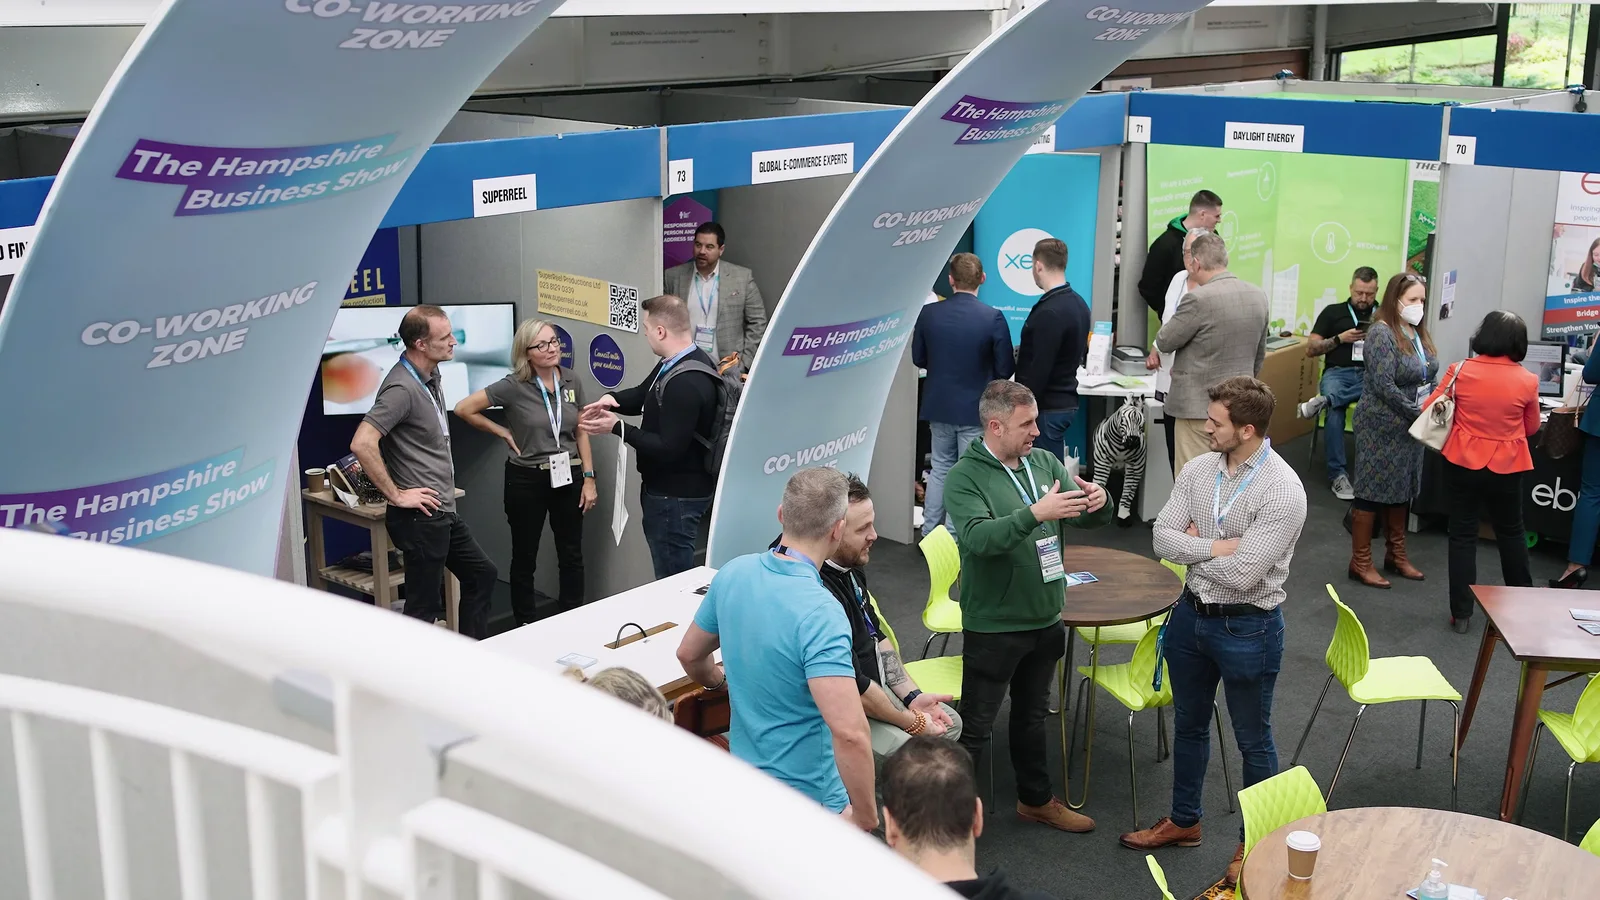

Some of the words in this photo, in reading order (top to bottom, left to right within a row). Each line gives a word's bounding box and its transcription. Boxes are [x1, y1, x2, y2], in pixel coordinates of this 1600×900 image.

[284, 0, 541, 24] CO-WORKING
[338, 28, 457, 49] ZONE
[1094, 27, 1149, 40] ZONE
[952, 101, 985, 119] The
[984, 103, 1062, 122] Hampshire
[960, 126, 1028, 141] Business
[1136, 124, 1143, 133] 71
[1233, 131, 1265, 141] DAYLIGHT
[1266, 132, 1295, 143] ENERGY
[1456, 144, 1467, 155] 70
[132, 149, 203, 176] The
[207, 143, 383, 177] Hampshire
[759, 160, 782, 173] GLOBAL
[783, 155, 822, 171] E-COMMERCE
[823, 153, 848, 166] EXPERTS
[184, 184, 328, 210] Business
[331, 156, 409, 191] Show
[677, 170, 686, 183] 73
[482, 187, 527, 204] SUPERREEL
[873, 198, 981, 229] CO-WORKING
[892, 225, 943, 247] ZONE
[538, 270, 563, 281] SuperReel
[563, 275, 593, 288] Productions
[592, 281, 602, 290] Ltd
[539, 293, 589, 307] www.superreel.co.uk
[539, 301, 589, 317] info@superreel.co.uk
[1564, 296, 1588, 304] Inspire
[81, 281, 318, 346] CO-WORKING
[1576, 309, 1599, 317] Bridge
[790, 334, 822, 350] The
[823, 317, 899, 347] Hampshire
[1546, 324, 1583, 334] Strengthen
[147, 327, 249, 369] ZONE
[811, 345, 875, 371] Business
[876, 331, 908, 353] Show
[763, 427, 868, 475] CO-WORKING
[0, 503, 67, 527] The
[75, 459, 236, 519] Hampshire
[204, 471, 271, 516] Show
